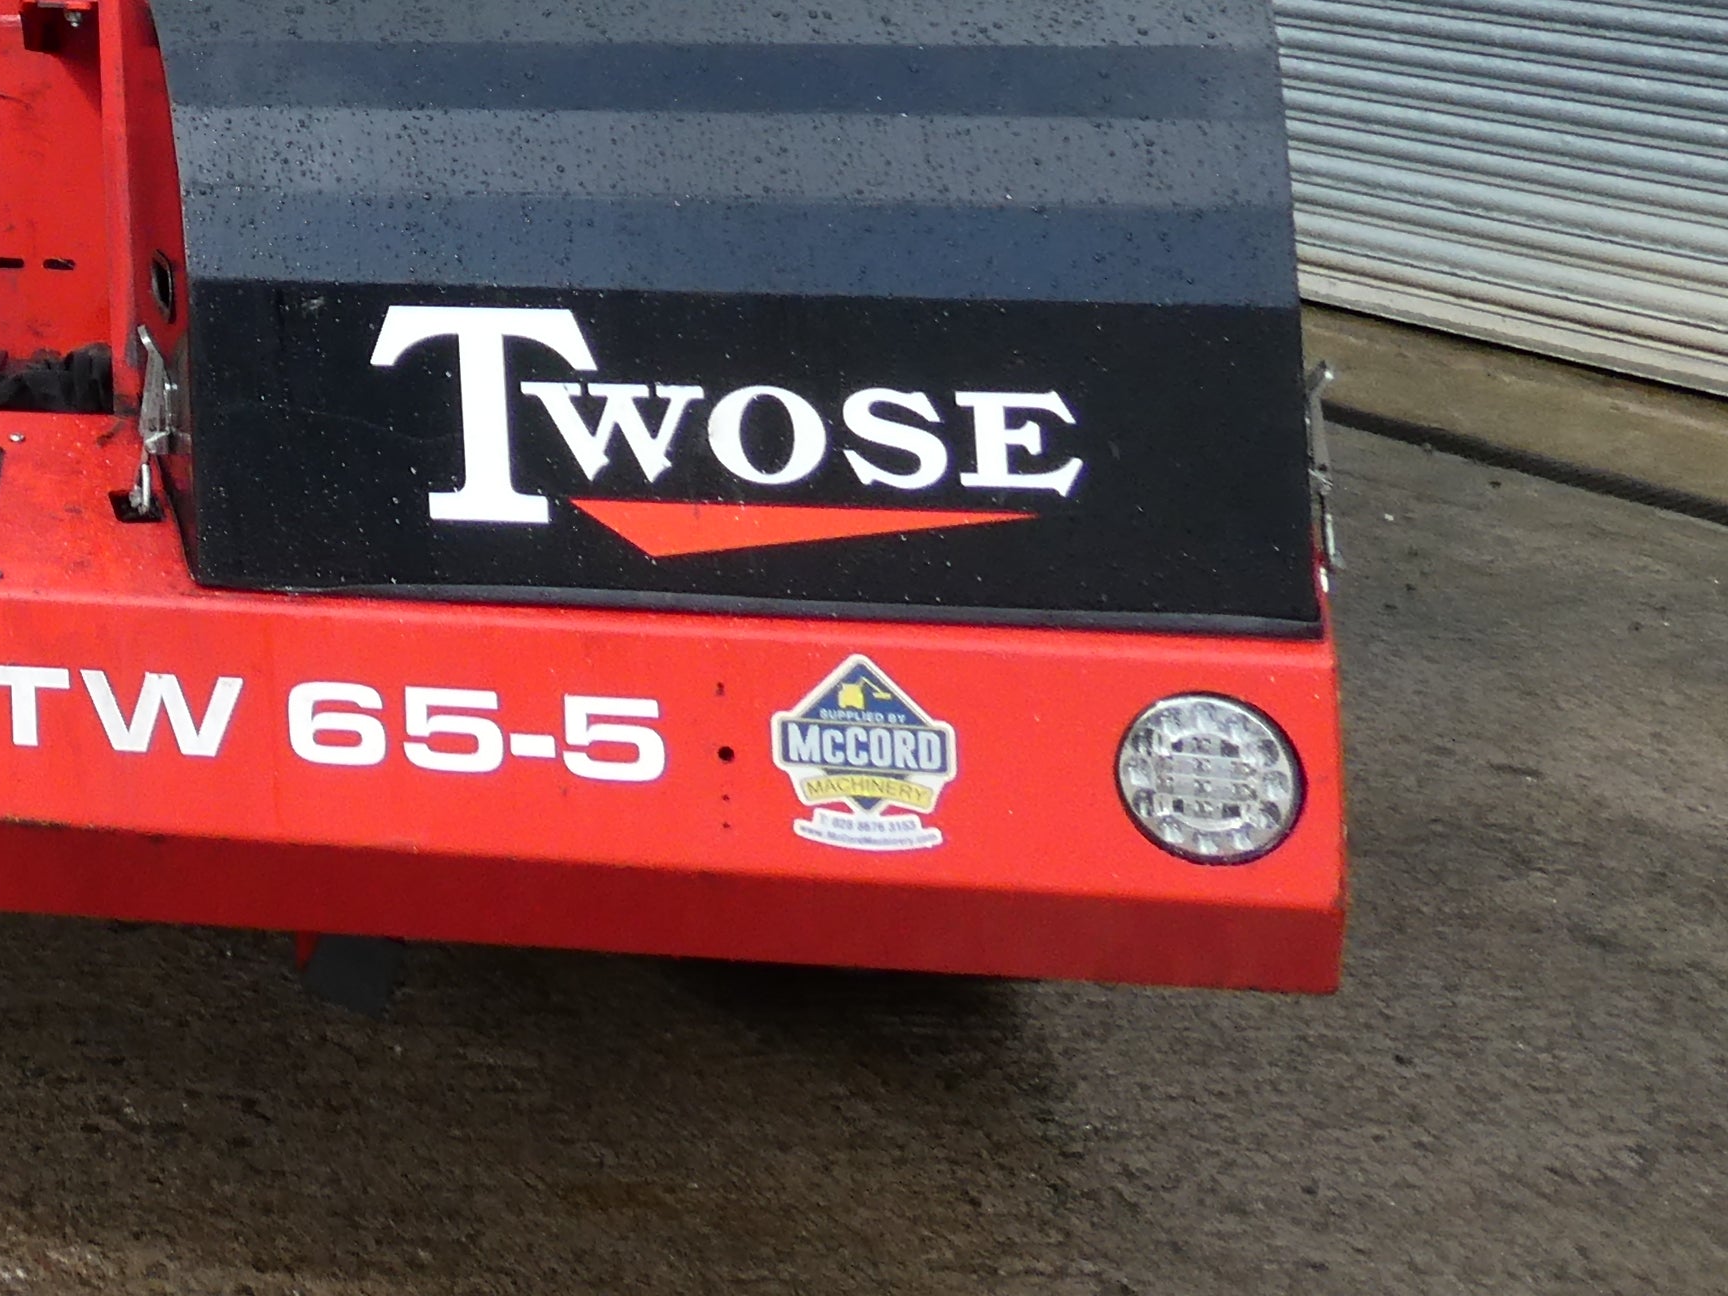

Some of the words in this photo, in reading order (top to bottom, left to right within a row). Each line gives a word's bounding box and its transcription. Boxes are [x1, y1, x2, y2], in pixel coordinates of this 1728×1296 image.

[819, 708, 884, 723] SUPPLIED
[887, 712, 906, 724] BY
[288, 680, 667, 783] 65-5
[806, 778, 928, 801] MACHINERY
